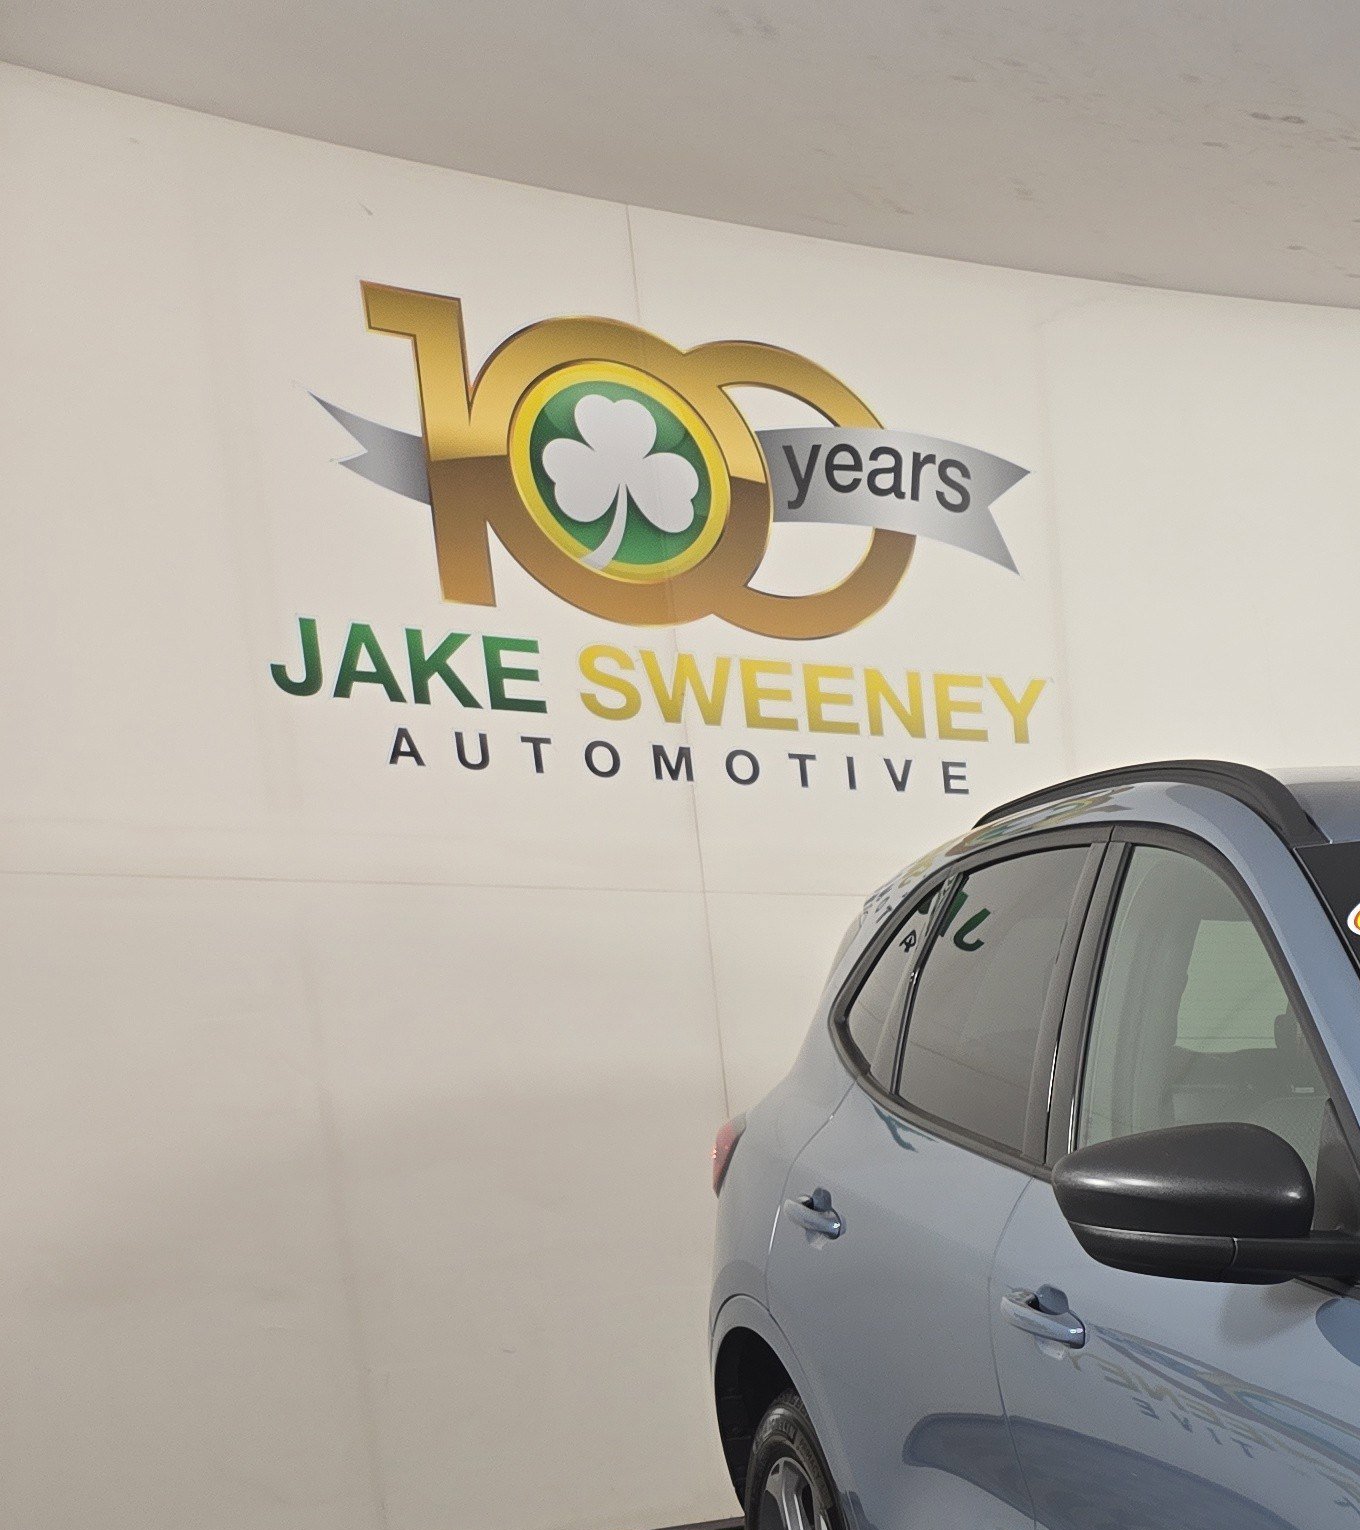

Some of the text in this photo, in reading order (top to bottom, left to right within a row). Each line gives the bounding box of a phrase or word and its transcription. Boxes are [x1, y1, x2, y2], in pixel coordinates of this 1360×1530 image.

[783, 441, 974, 515] years
[270, 616, 1046, 744] JAKE SWEENEY
[389, 727, 971, 795] AUTOMOTIVE
